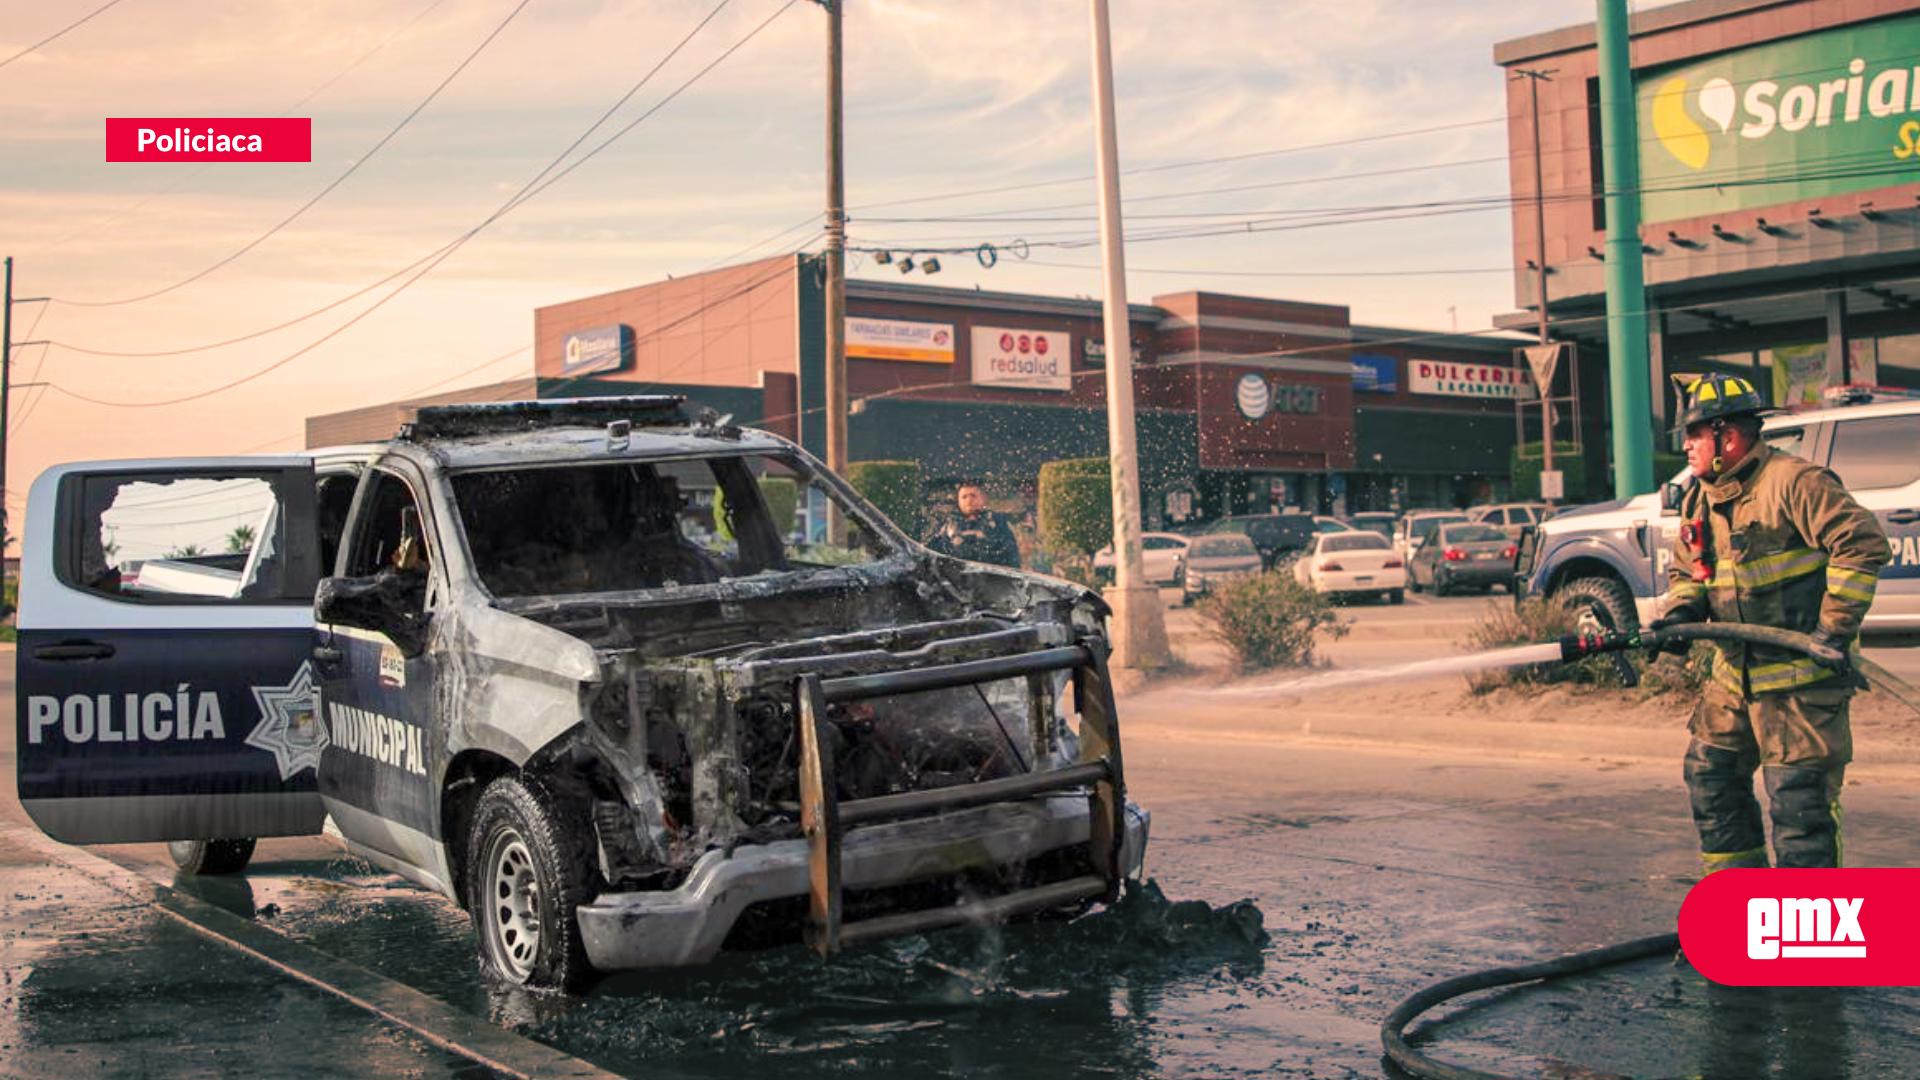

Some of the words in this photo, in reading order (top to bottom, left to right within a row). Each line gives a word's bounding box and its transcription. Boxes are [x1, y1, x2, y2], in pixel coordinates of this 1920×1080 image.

[1740, 58, 1920, 138] Soria
[991, 355, 1057, 377] redsalud
[28, 683, 226, 744] POLICÍA
[329, 701, 427, 776] MUNICIPAL
